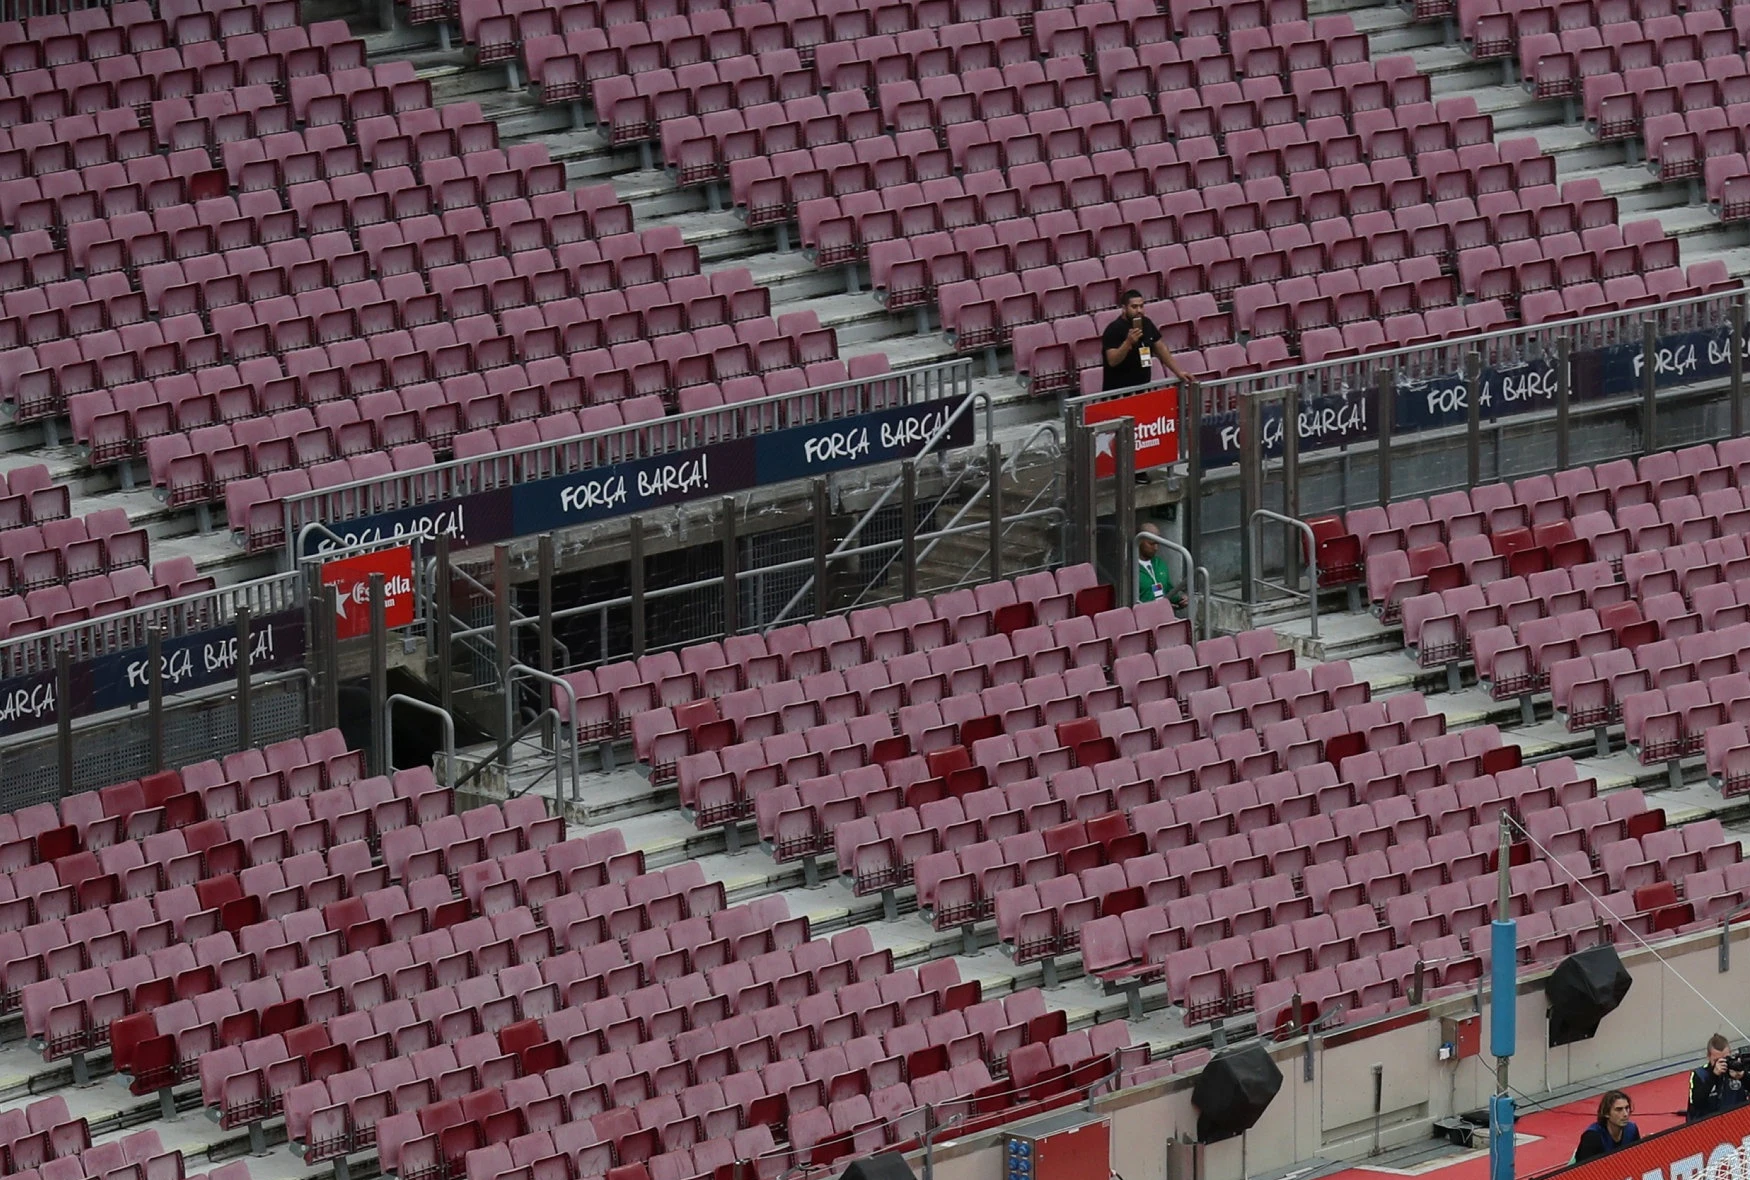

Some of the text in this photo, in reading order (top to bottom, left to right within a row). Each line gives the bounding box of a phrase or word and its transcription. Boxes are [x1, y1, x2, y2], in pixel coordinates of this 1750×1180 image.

[1633, 344, 1697, 377] FRÇA
[1427, 361, 1573, 414] FORA BARÇ!
[804, 405, 951, 463] FORÇA BARÇA!
[1221, 397, 1367, 450] FÇA BARÇA!
[561, 453, 708, 512] FORÇA BARÇA!
[352, 575, 411, 605] Esella
